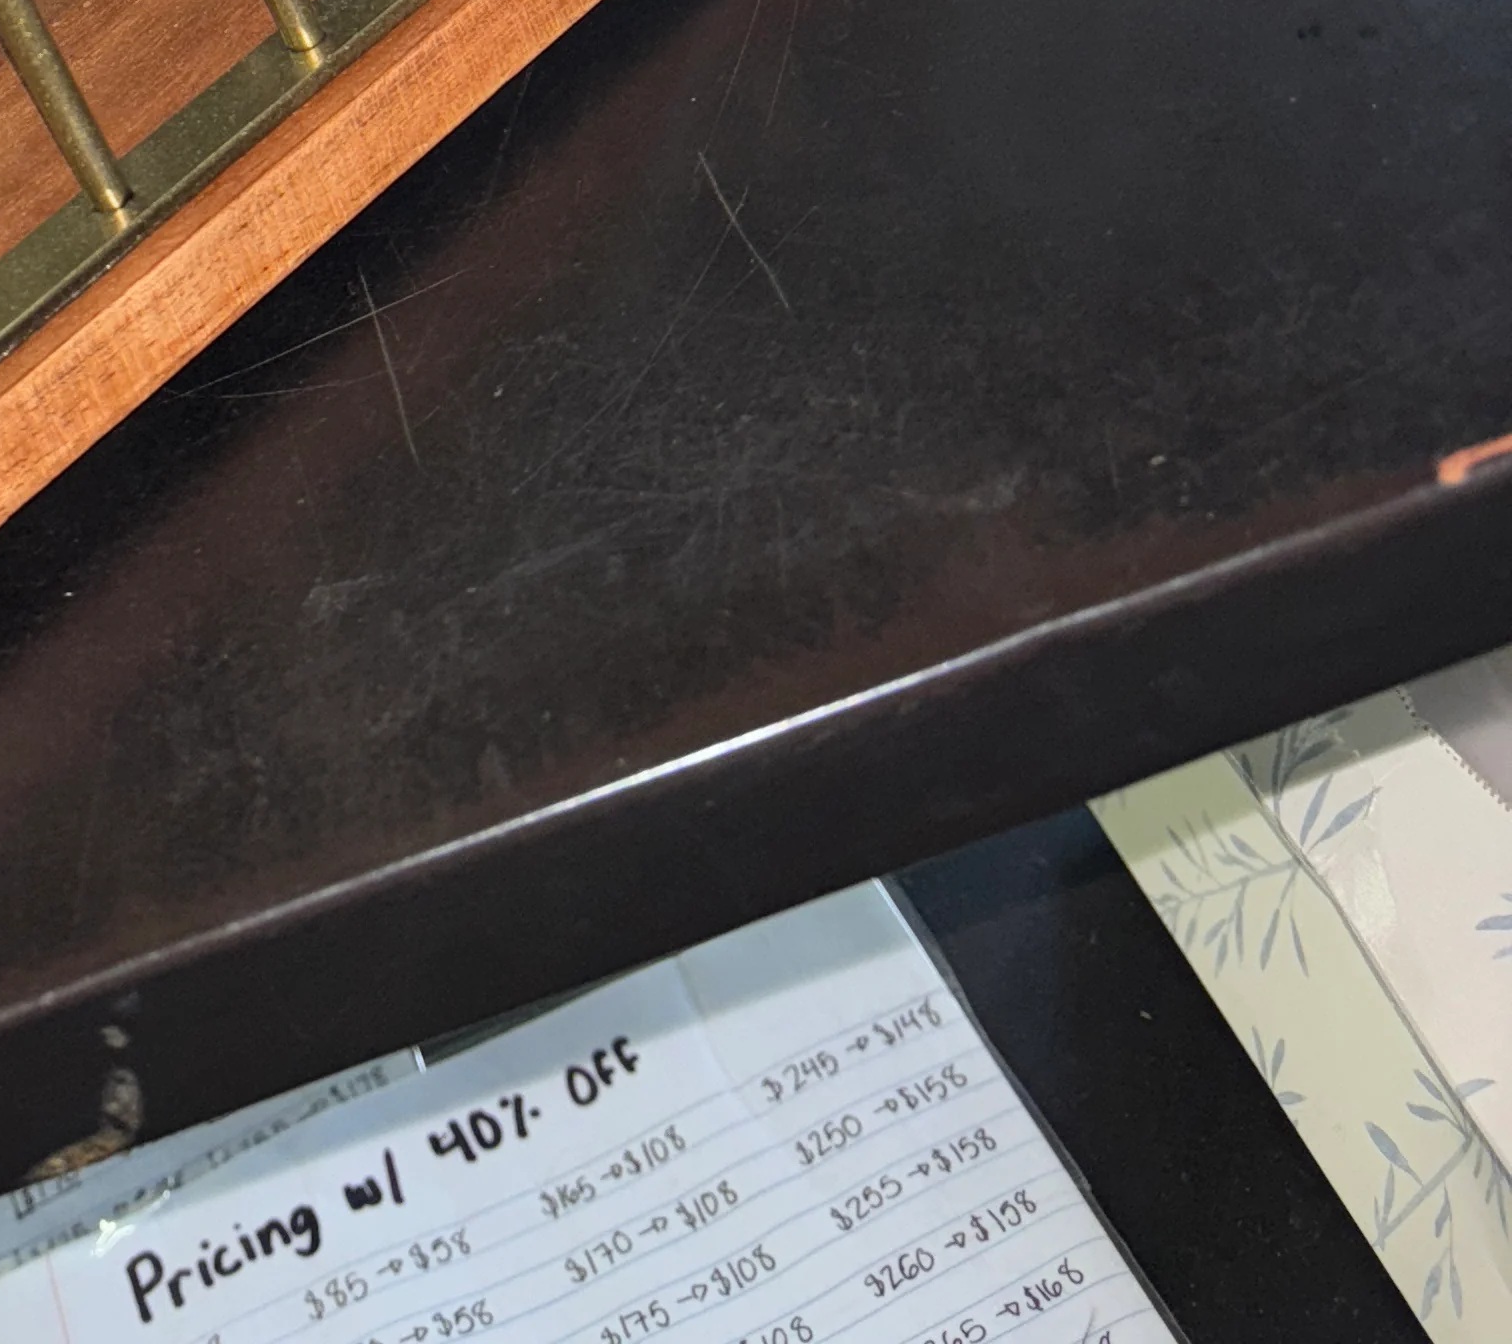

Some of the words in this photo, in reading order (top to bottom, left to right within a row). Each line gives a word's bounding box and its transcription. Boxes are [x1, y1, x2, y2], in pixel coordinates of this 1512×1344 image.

[873, 996, 943, 1047] $148
[622, 1124, 687, 1177] $108
[795, 1113, 863, 1165] $250
[896, 1062, 968, 1111] $158
[126, 1203, 321, 1323] Pricing
[344, 1146, 405, 1210] w/
[428, 1094, 540, 1162] 40%
[566, 1036, 640, 1107] OFF
[830, 1174, 903, 1232] $255
[931, 1127, 998, 1173] $158
[304, 1271, 369, 1321] $85
[408, 1227, 472, 1272] $58
[564, 1230, 634, 1285] $170
[675, 1179, 740, 1233] $108
[864, 1247, 936, 1299] $260
[970, 1189, 1038, 1243] $158
[432, 1297, 495, 1338] $58
[600, 1299, 672, 1344] $175
[710, 1243, 777, 1298] $108
[1022, 1257, 1085, 1312] $168
